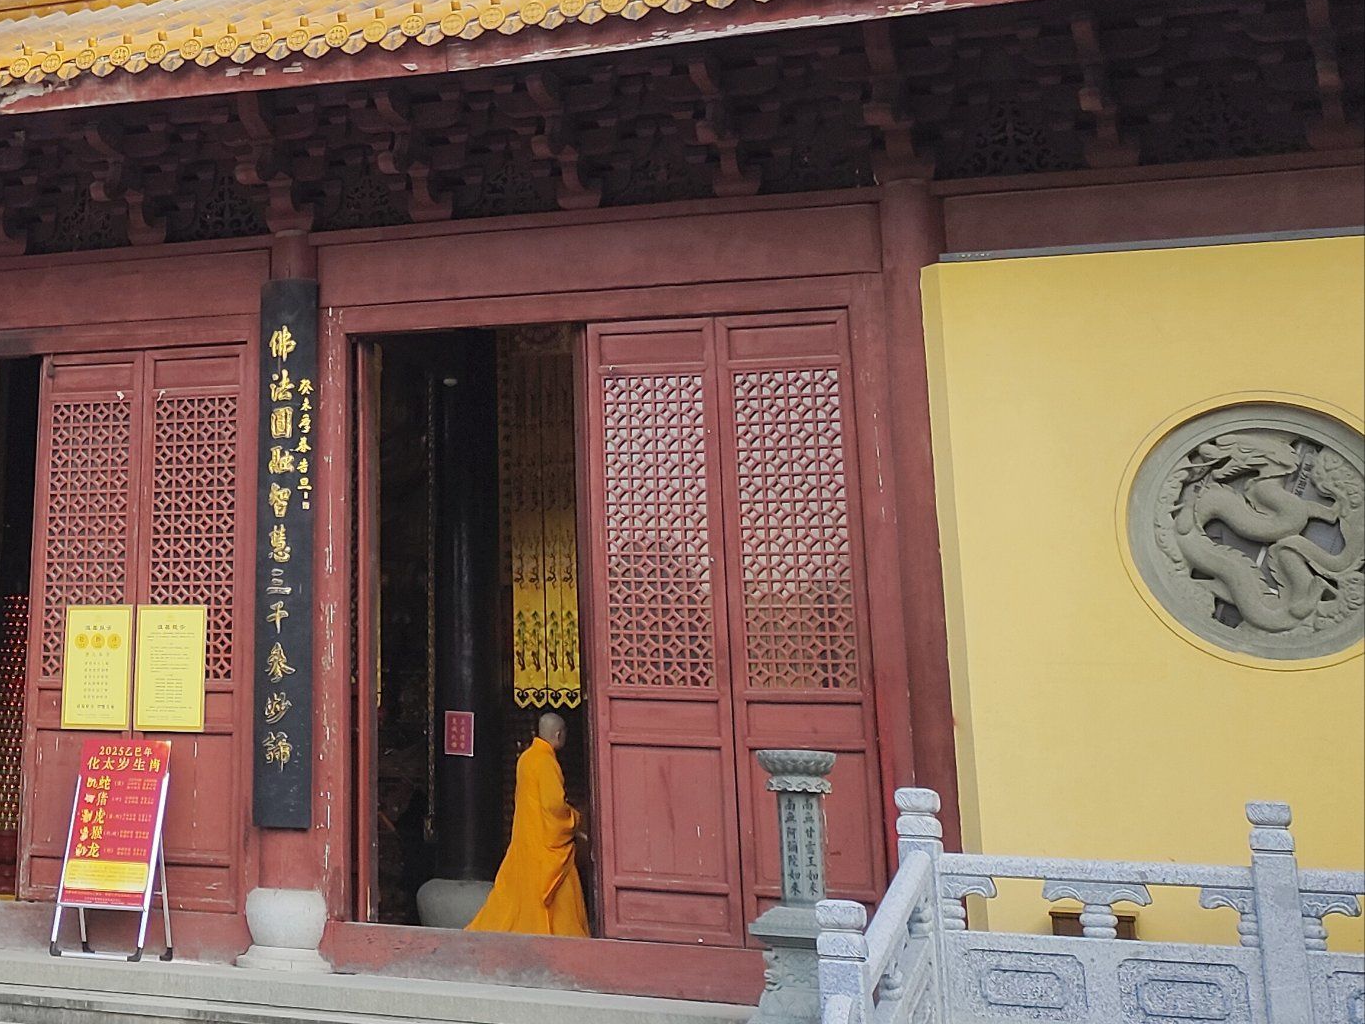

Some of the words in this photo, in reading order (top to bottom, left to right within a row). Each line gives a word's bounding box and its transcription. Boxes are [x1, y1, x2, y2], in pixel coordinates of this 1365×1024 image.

[99, 745, 153, 757] 2025乙巳年
[87, 756, 161, 773] 化太岁生肖
[97, 775, 111, 790] 蛇
[93, 807, 106, 824] 虎
[85, 842, 100, 858] 龙
